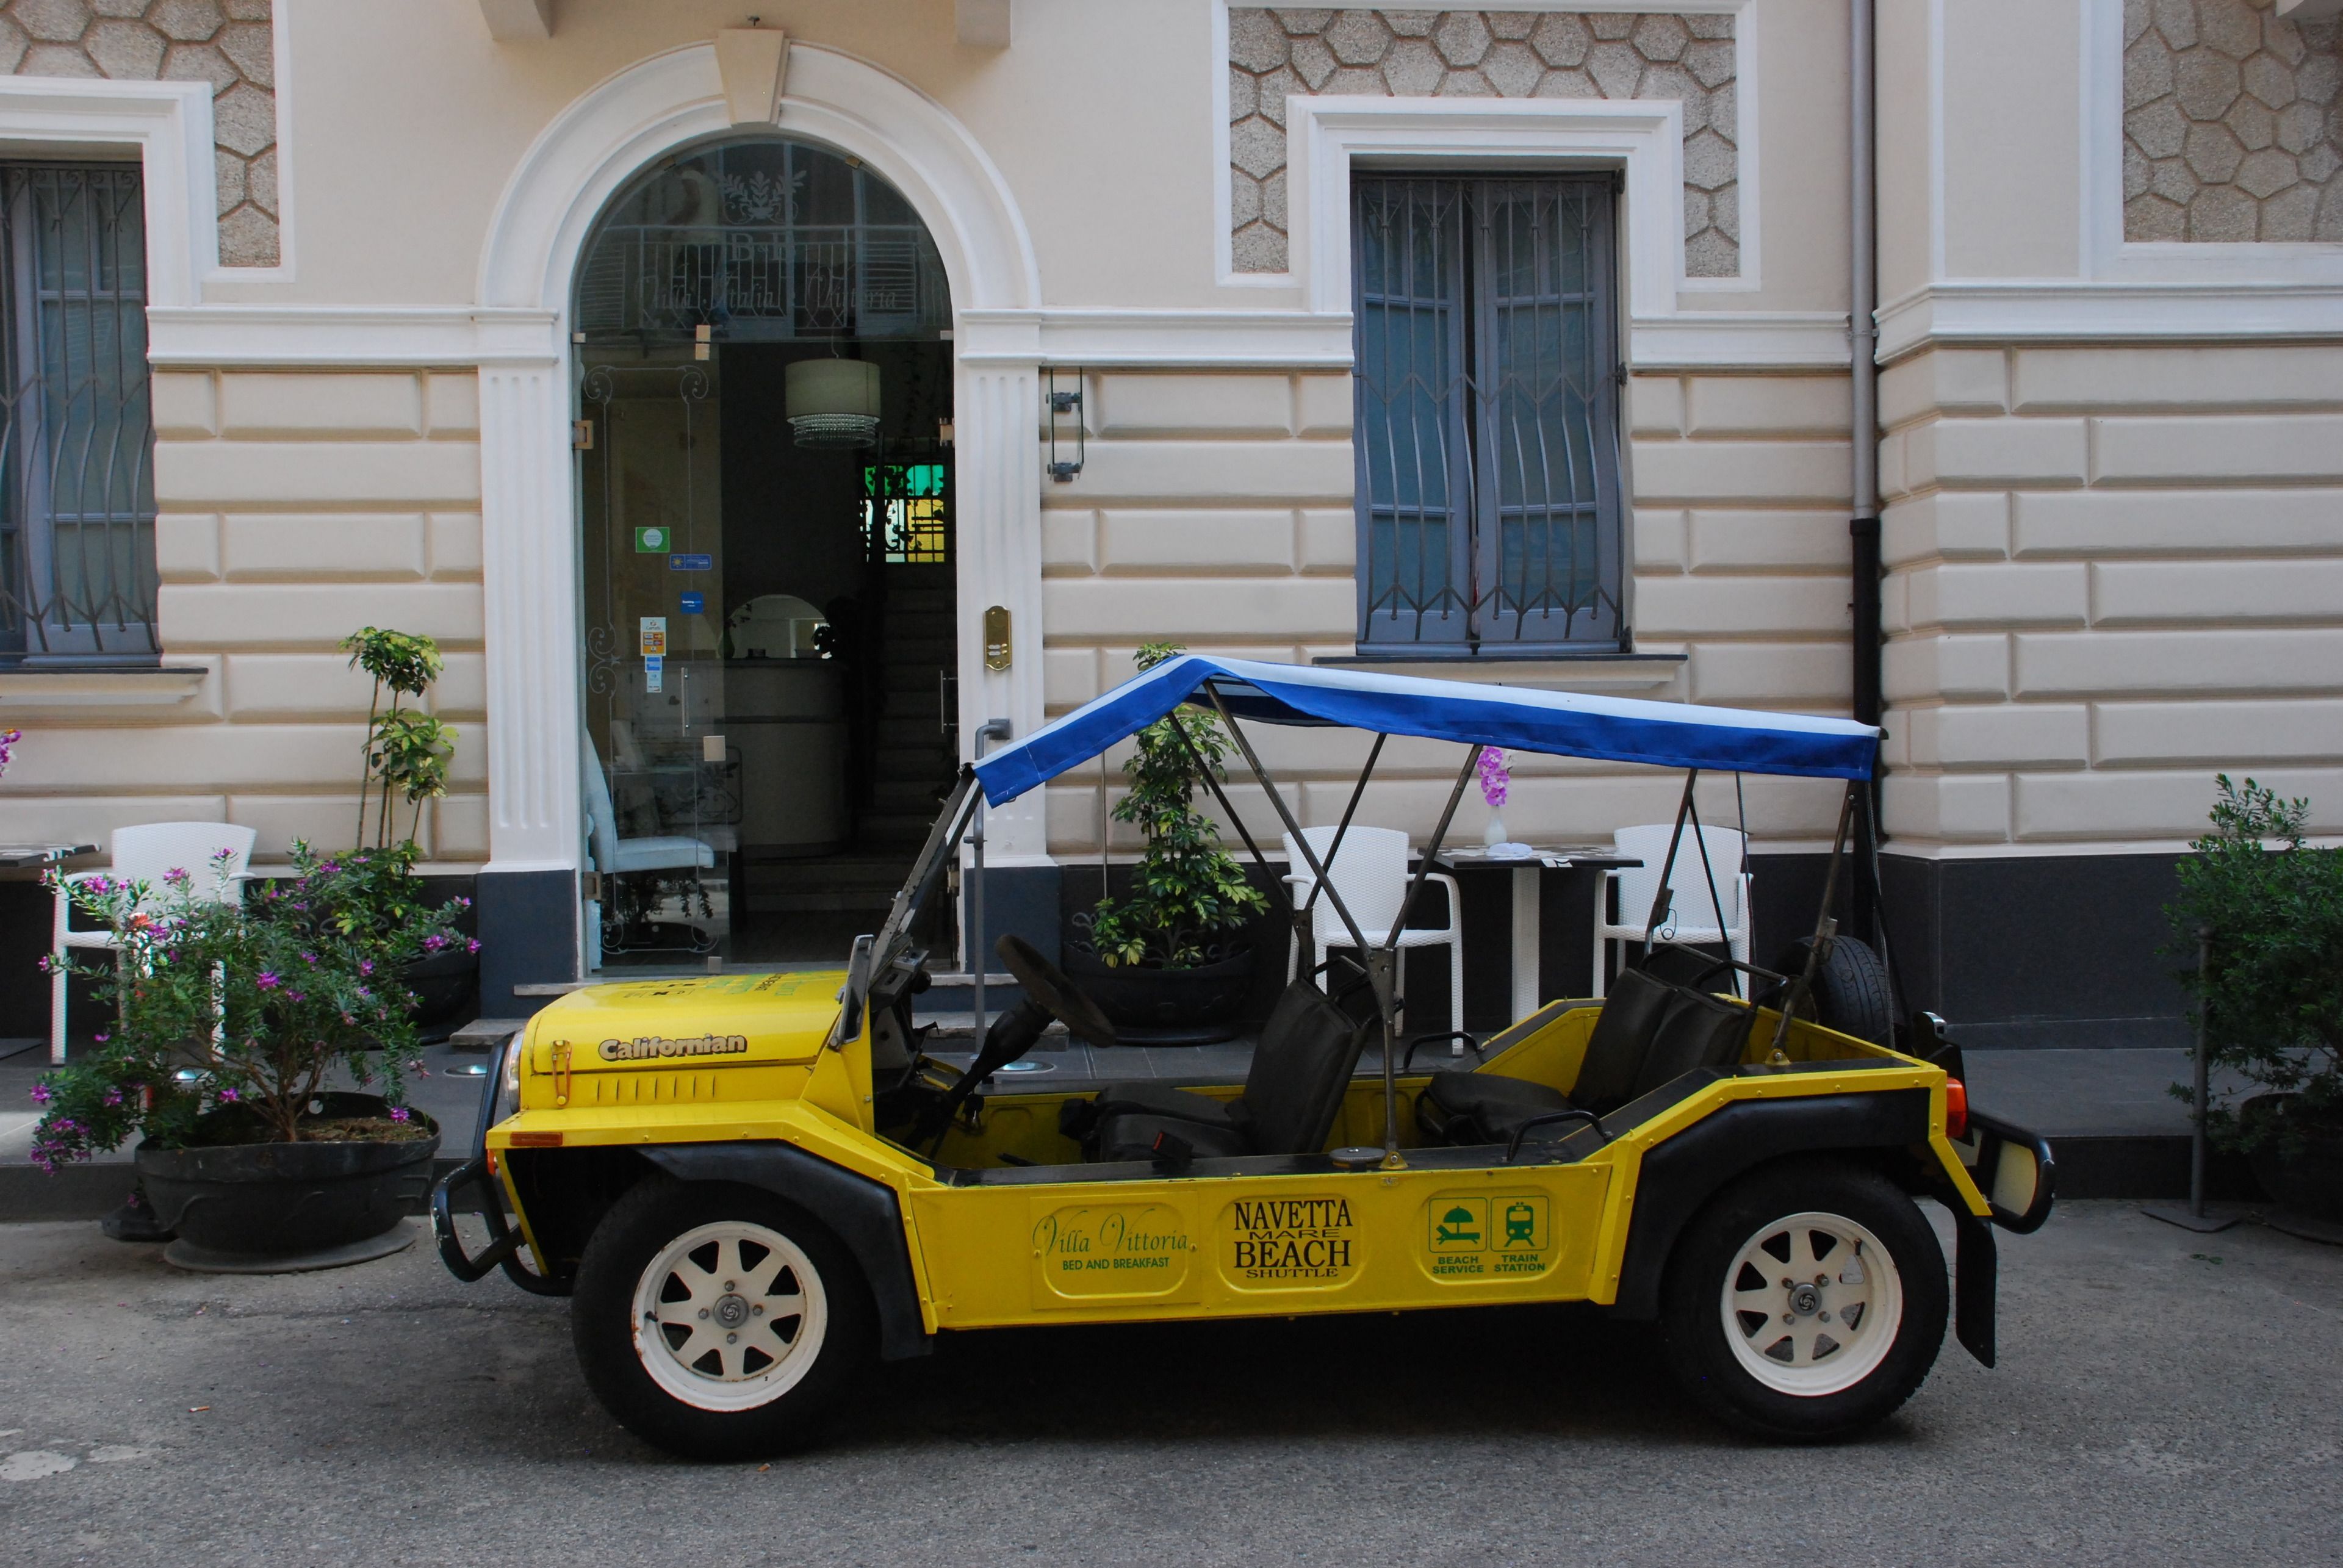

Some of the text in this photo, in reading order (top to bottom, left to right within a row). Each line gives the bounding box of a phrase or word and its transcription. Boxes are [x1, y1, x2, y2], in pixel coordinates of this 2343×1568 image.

[808, 262, 898, 312] Vitria
[599, 1033, 747, 1061] Californian
[1234, 1199, 1353, 1230] NAVETTA
[1032, 1208, 1187, 1257] Villa Vittoria
[1250, 1228, 1340, 1240] MARE
[1234, 1240, 1351, 1268] BEACH
[1501, 1254, 1538, 1263] TRAIN
[1062, 1257, 1170, 1270] BED AND BREAKFAST
[1438, 1256, 1479, 1265] BEACH
[1247, 1268, 1339, 1278] SHUTTLE
[1433, 1265, 1484, 1274] SERVICE
[1494, 1263, 1546, 1272] STATION
